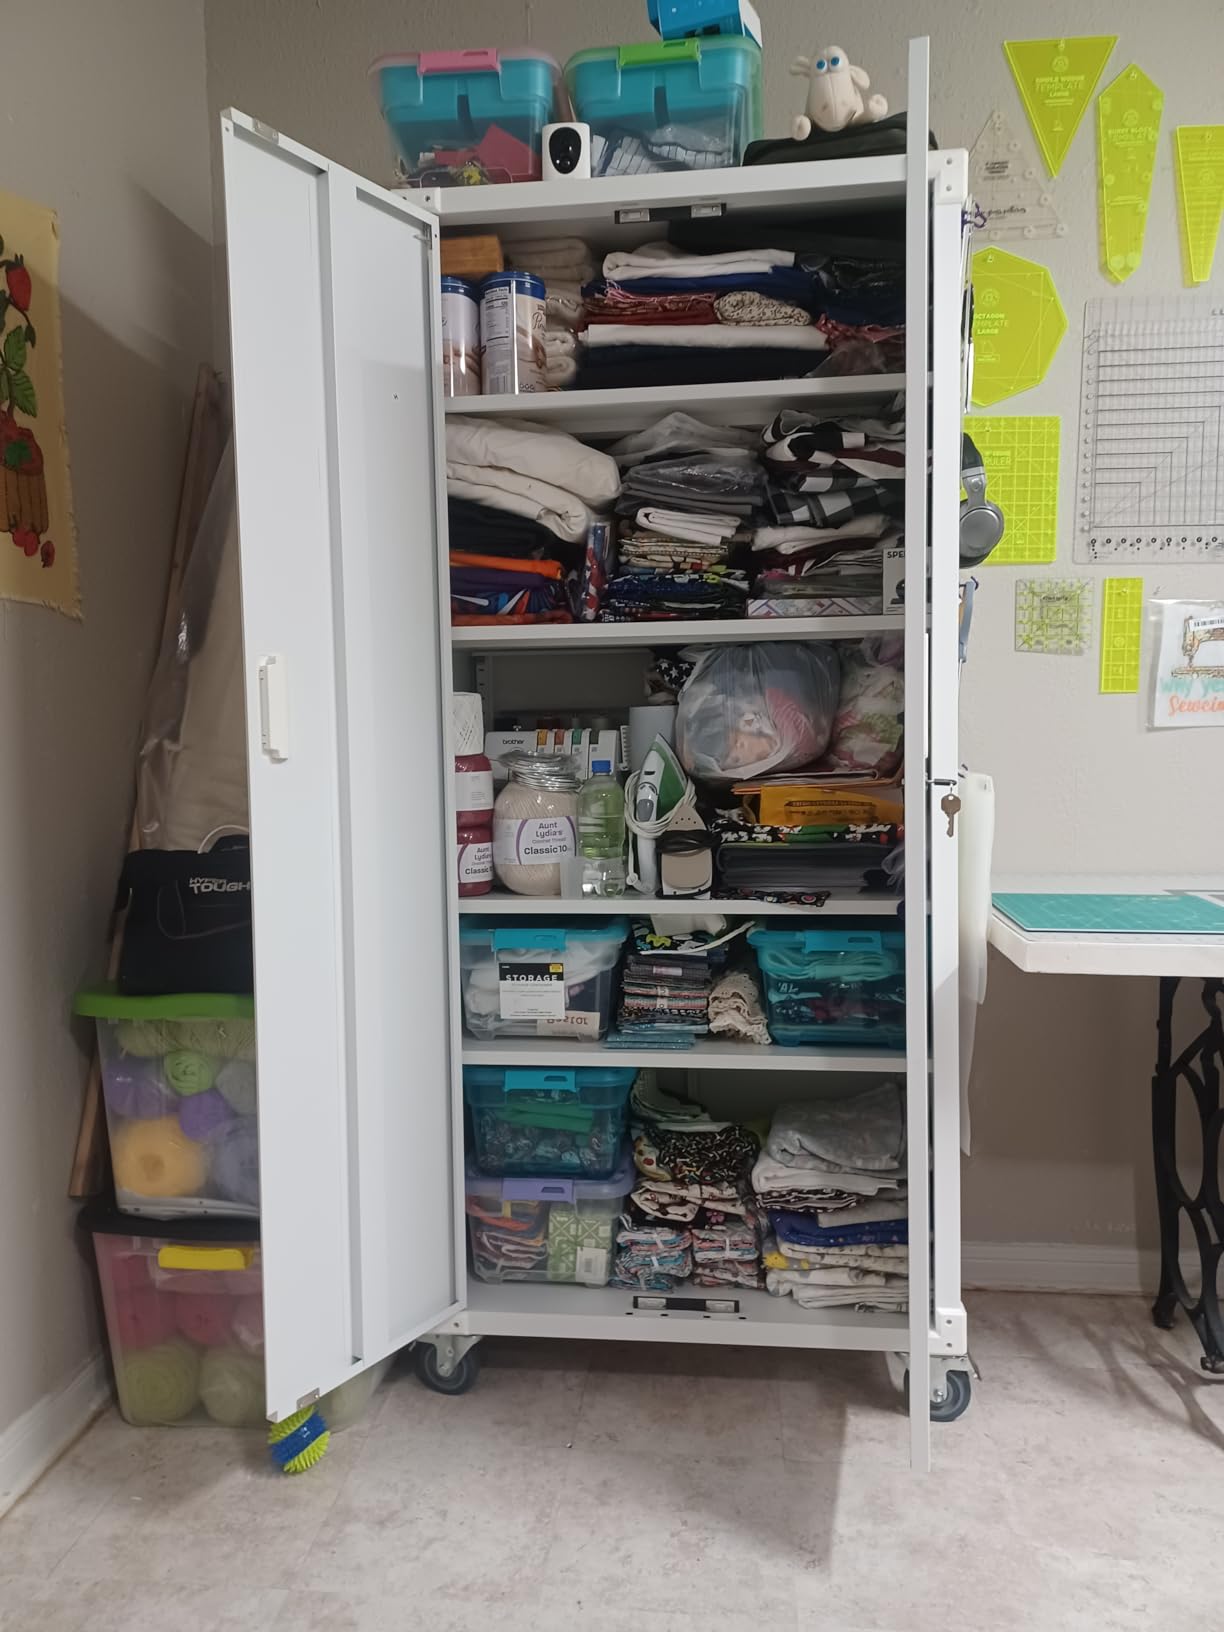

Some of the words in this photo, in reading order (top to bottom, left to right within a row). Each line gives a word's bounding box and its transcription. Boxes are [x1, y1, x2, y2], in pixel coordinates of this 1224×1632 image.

[887, 550, 905, 559] SPE
[535, 829, 563, 839] Lydia's
[524, 846, 558, 855] Classic
[558, 844, 568, 852] 10
[465, 866, 489, 875] Classic
[189, 881, 250, 894] TOUGH
[505, 974, 558, 983] STORAGE
